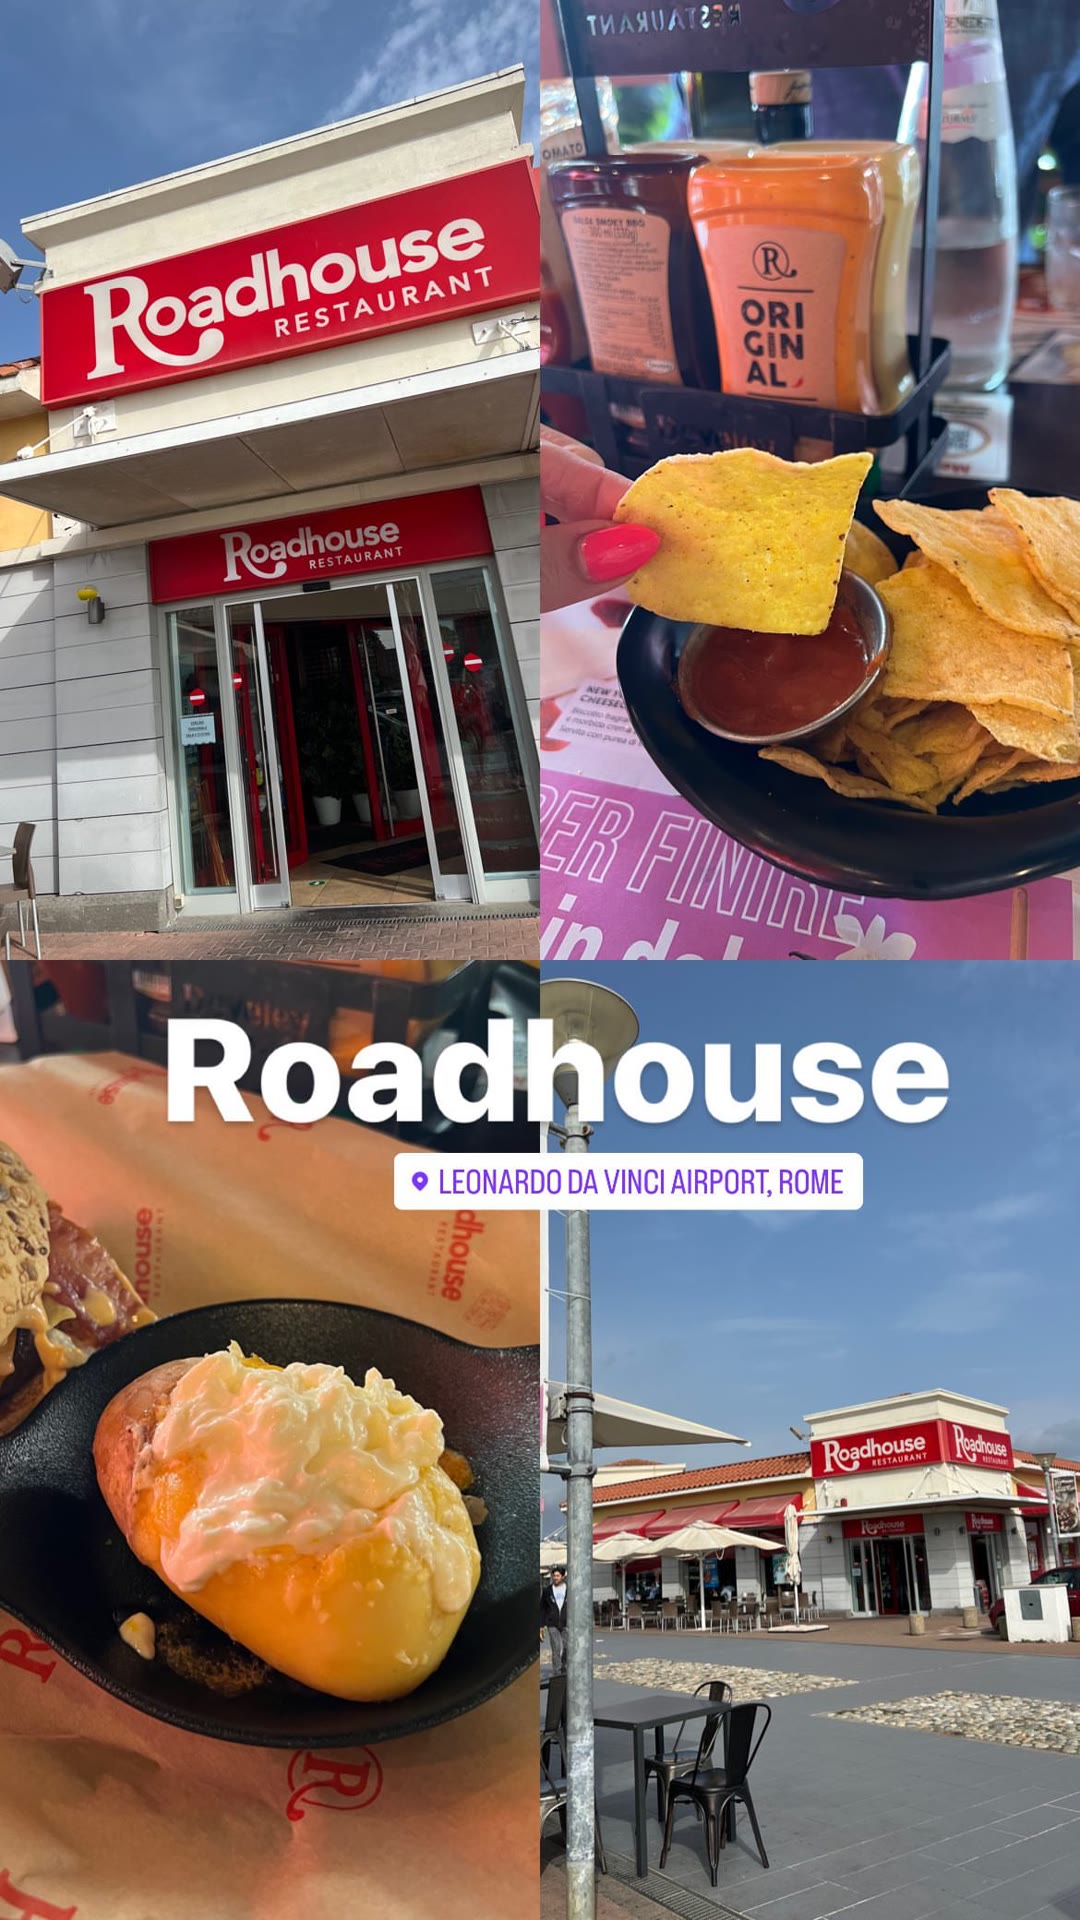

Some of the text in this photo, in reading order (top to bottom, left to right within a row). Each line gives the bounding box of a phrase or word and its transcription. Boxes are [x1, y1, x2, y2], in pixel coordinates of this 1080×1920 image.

[84, 217, 486, 380] Roadhouse
[274, 265, 494, 339] RESTAURANT
[741, 299, 804, 329] ORI
[743, 330, 804, 360] GIN
[219, 522, 400, 582] Roadhouse
[309, 546, 403, 570] RESTAURANT
[587, 685, 612, 696] NEW
[135, 1207, 152, 1304] house
[822, 1436, 926, 1473] Roadhouse
[872, 1452, 928, 1466] RESTAURANT
[953, 1425, 1008, 1463] Roadhouse
